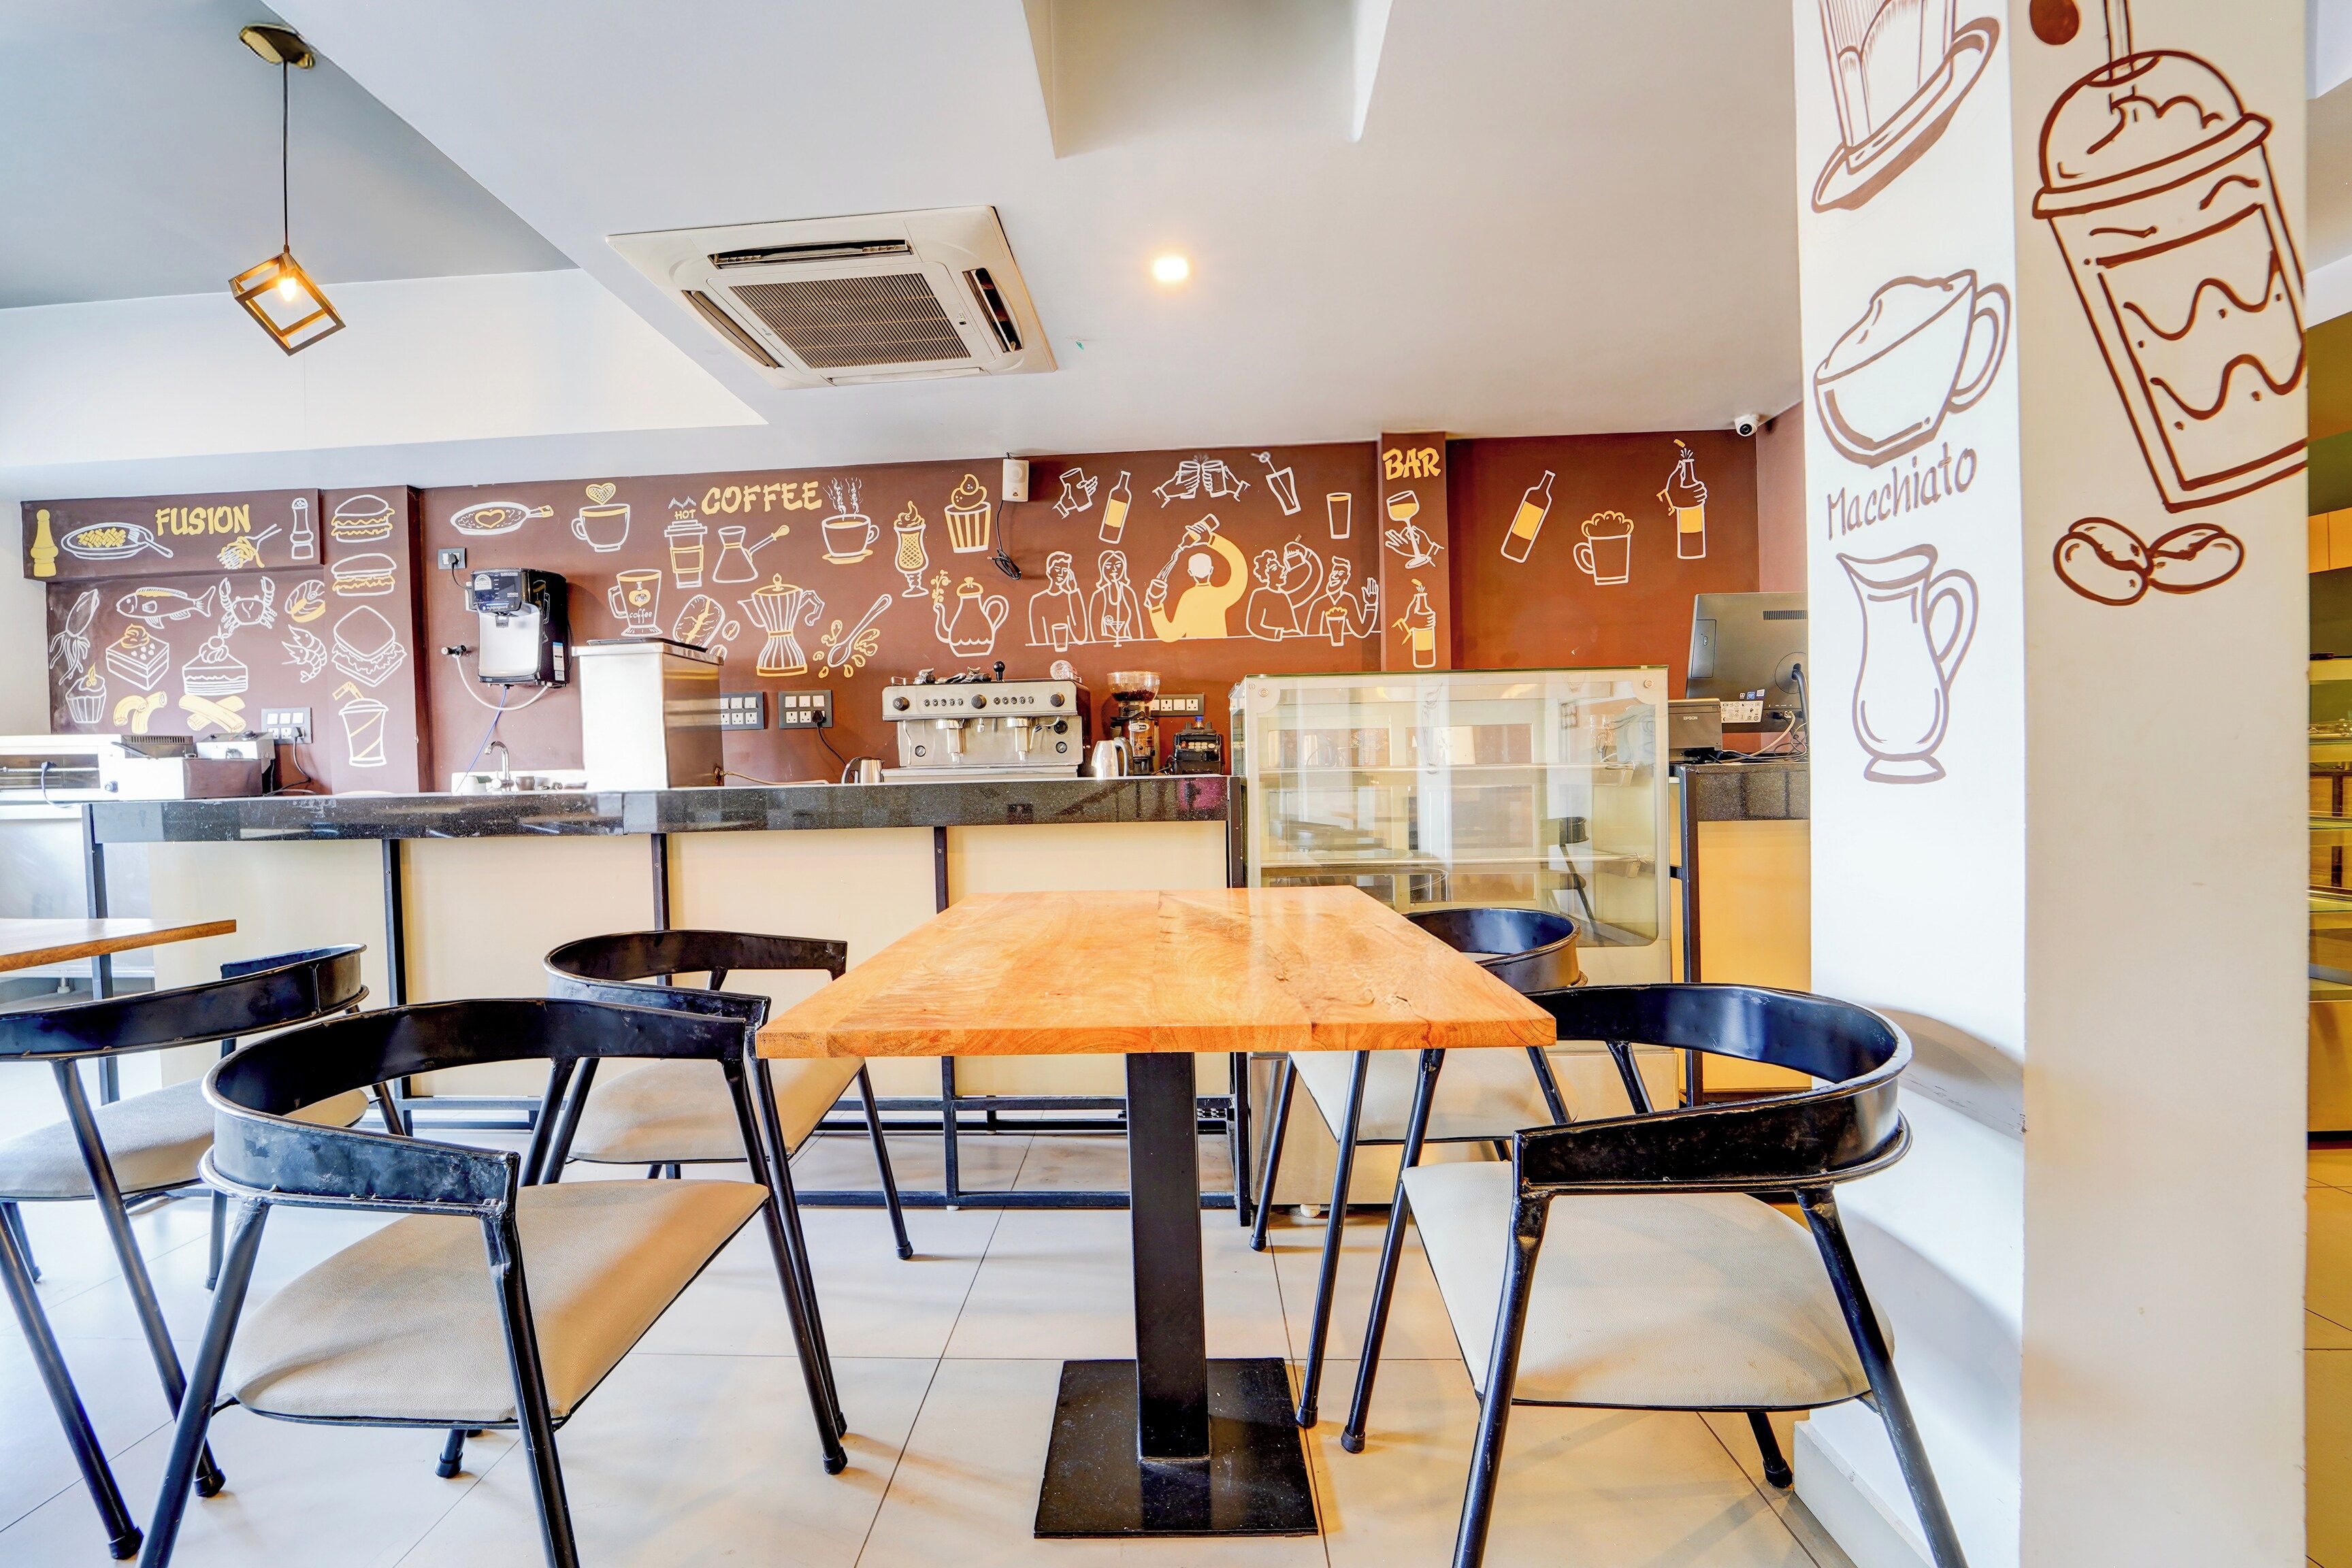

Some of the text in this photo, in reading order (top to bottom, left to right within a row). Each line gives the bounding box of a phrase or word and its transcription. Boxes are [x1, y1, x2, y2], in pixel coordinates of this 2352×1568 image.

[1382, 447, 1441, 480] BAR
[701, 481, 823, 515] COFFEE
[1827, 442, 1978, 541] Macchiato
[155, 504, 252, 536] FUSION
[674, 509, 696, 520] HOT
[629, 608, 653, 624] coffee
